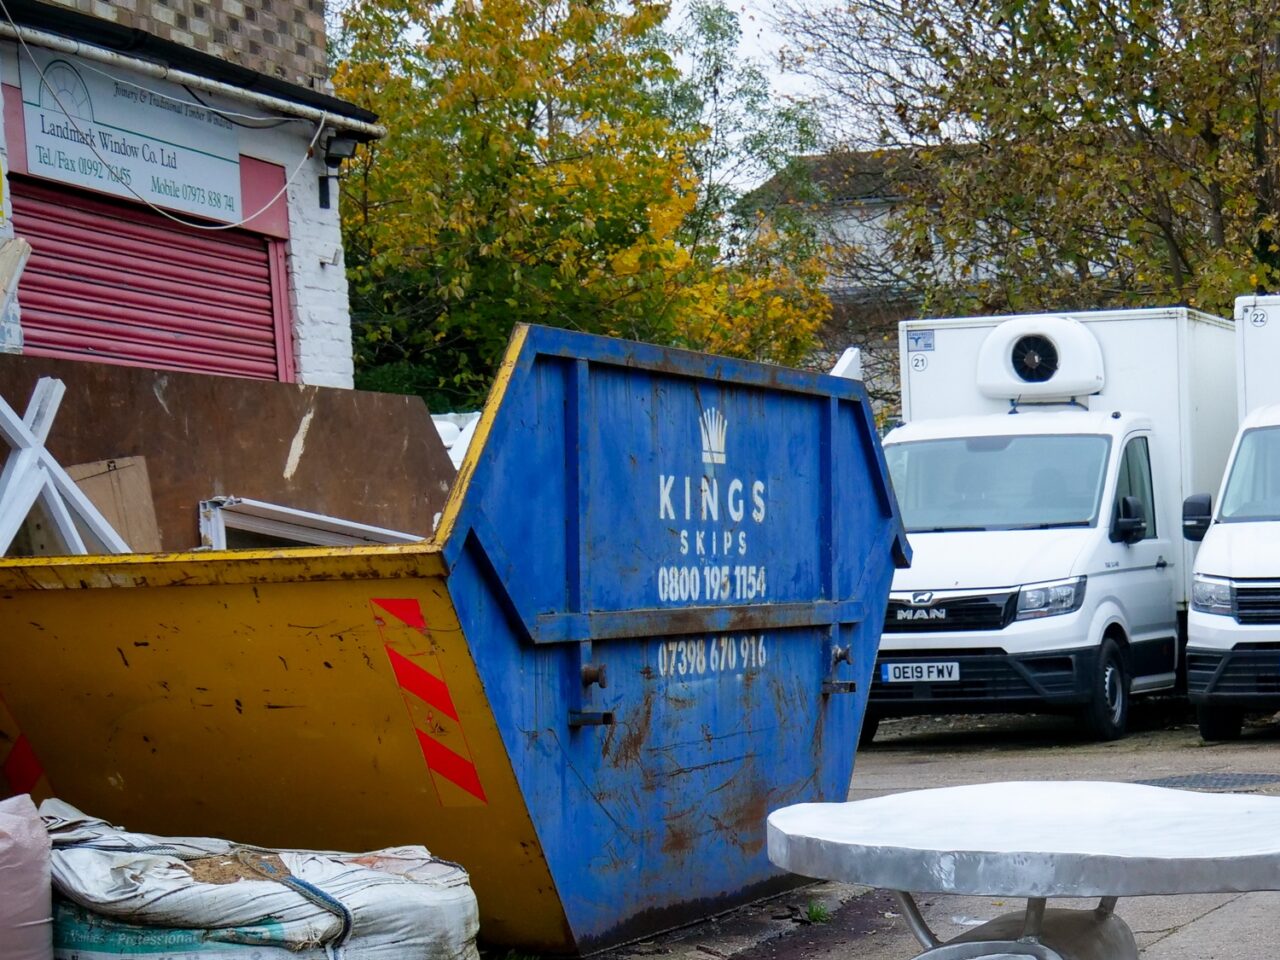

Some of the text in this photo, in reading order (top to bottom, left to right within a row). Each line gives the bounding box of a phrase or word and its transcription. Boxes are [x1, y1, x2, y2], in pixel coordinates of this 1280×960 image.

[139, 90, 147, 103] &
[40, 113, 178, 169] Landmark Window Co. Ltd
[78, 156, 103, 179] 01992
[151, 175, 236, 213] Mobile 07973 838 741
[1252, 313, 1265, 323] 22
[913, 358, 925, 368] 21
[659, 474, 766, 523] KINGS
[680, 529, 748, 555] SKIPS
[658, 565, 766, 602] 0800 195 1154
[896, 608, 946, 620] MAN
[658, 634, 767, 677] 07398 670 916
[893, 664, 954, 680] OE19 FWV
